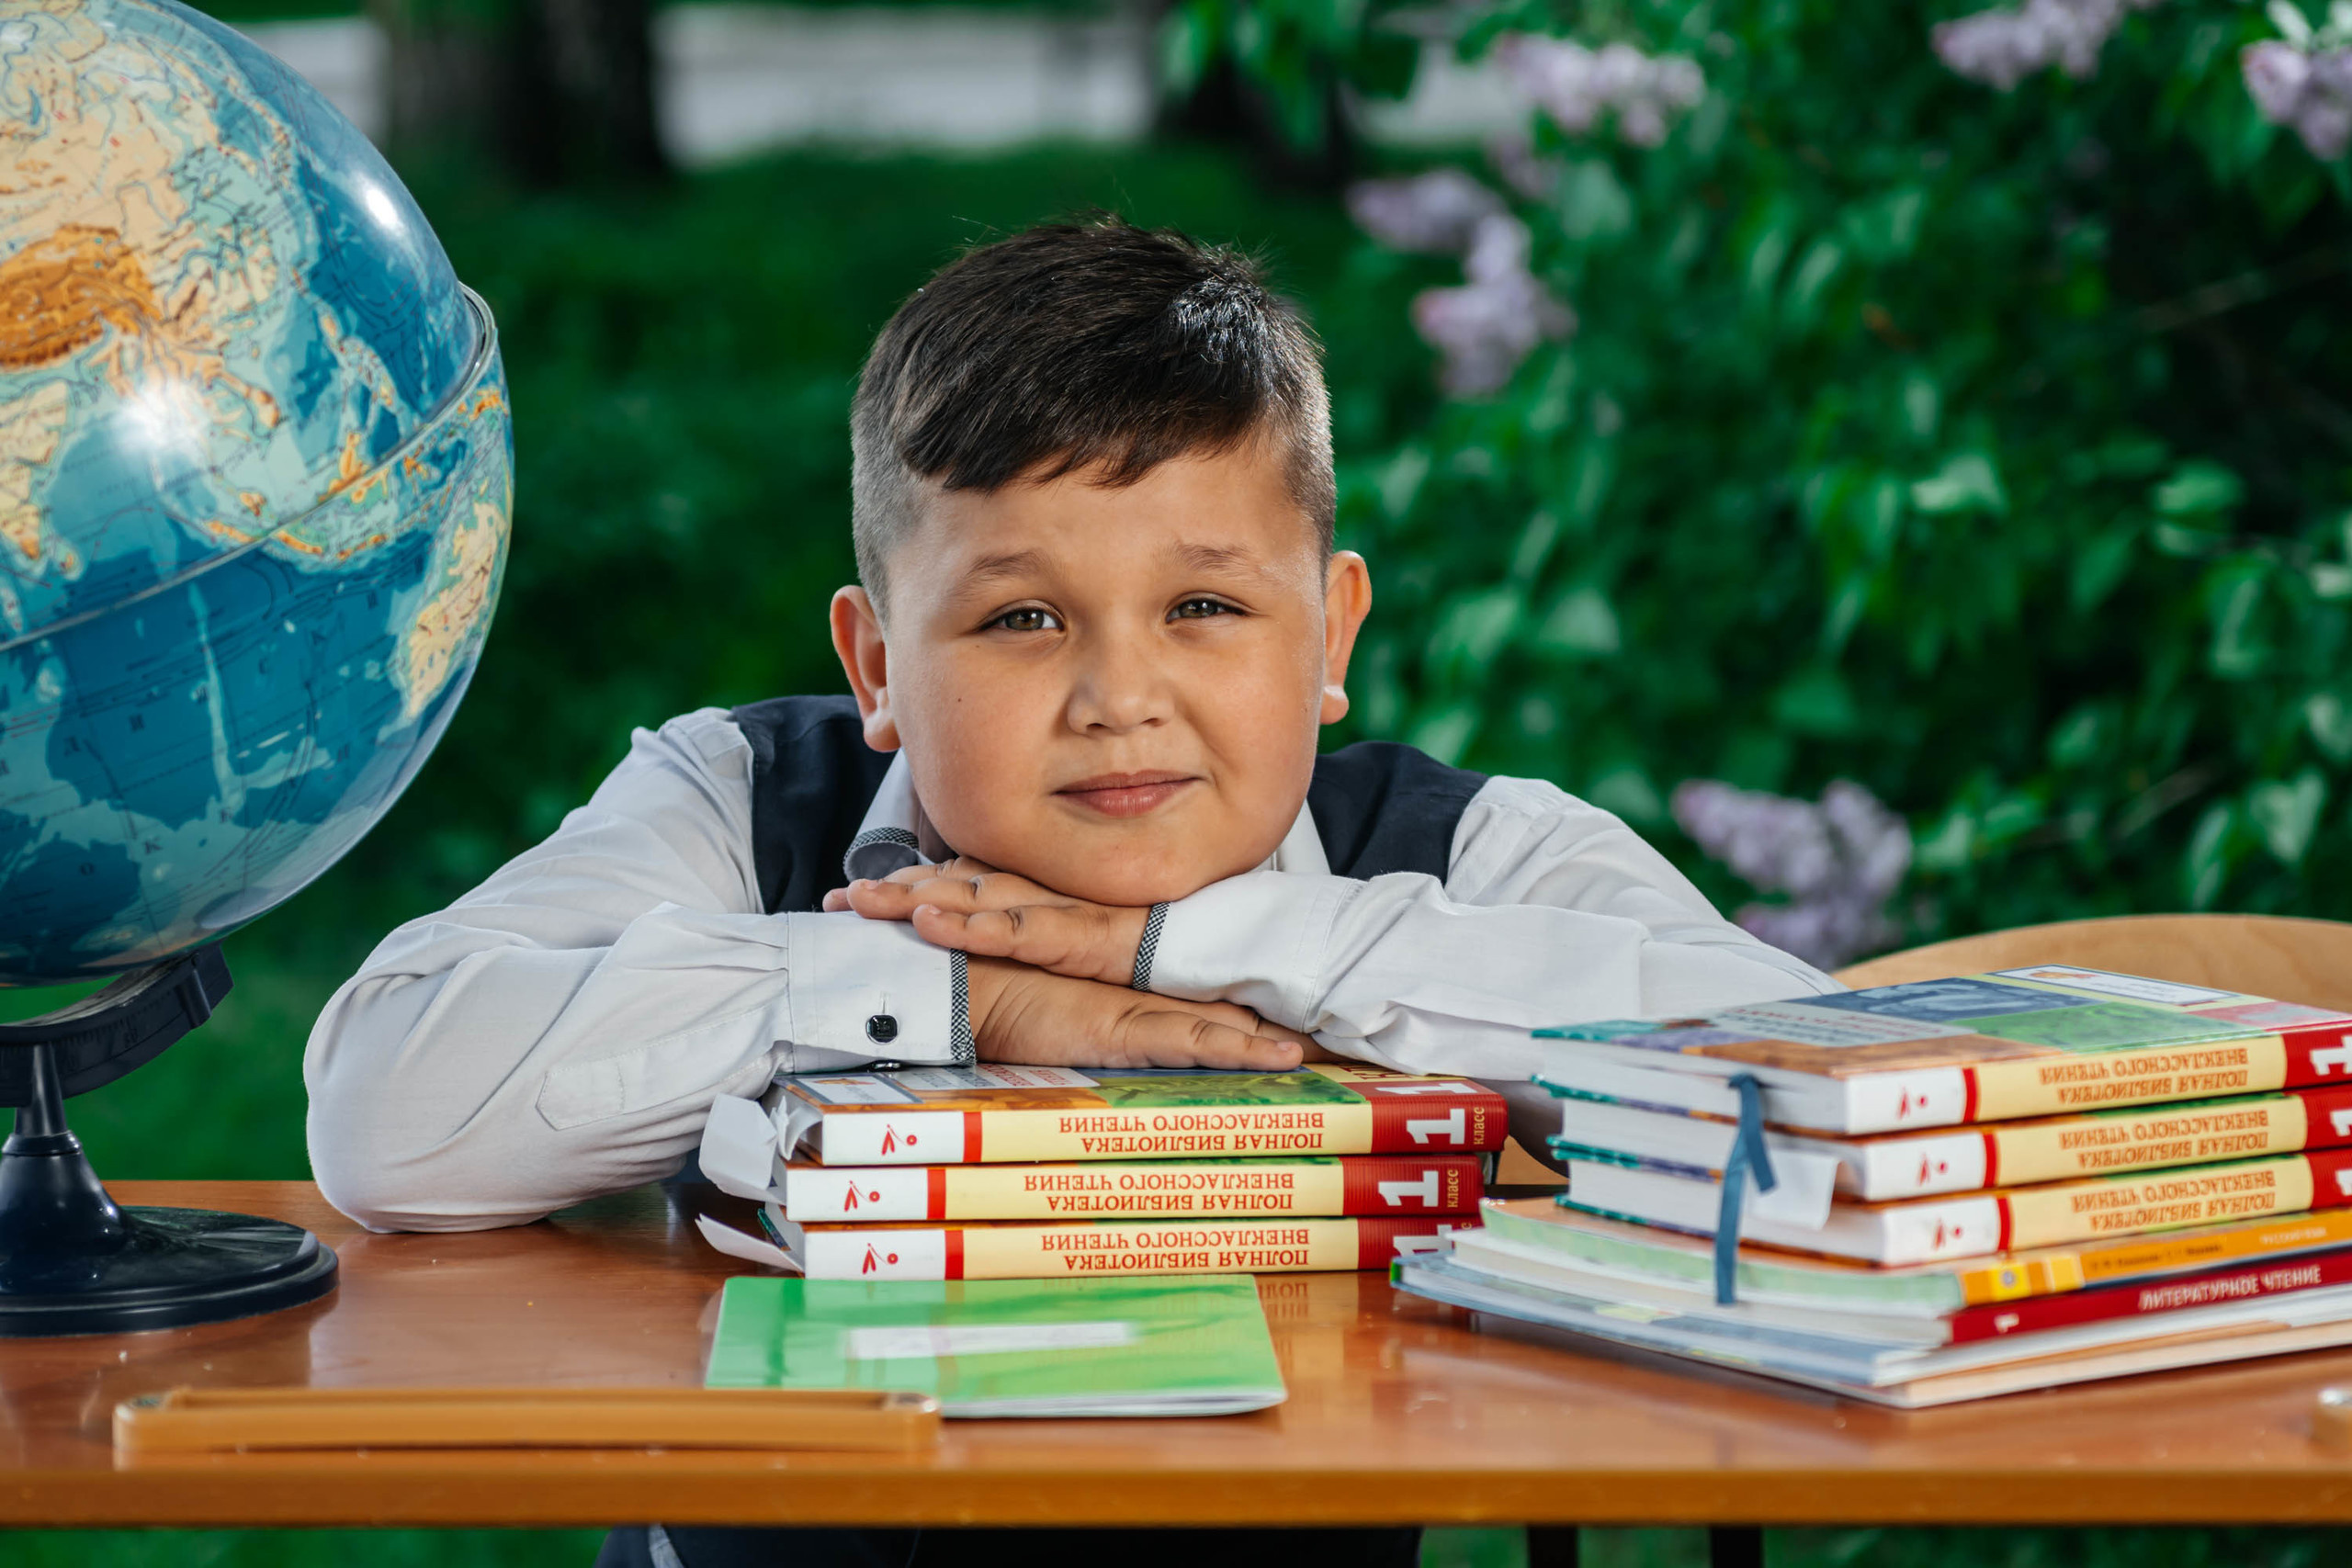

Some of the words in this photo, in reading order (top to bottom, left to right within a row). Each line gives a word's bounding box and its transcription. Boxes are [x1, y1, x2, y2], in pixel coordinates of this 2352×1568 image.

[2040, 1063, 2110, 1085] ЧТЕНИЯ
[2113, 1048, 2248, 1077] ВНЕКЛАССНОГО
[2058, 1077, 2172, 1104] БИБЛИОТЕКА
[2178, 1070, 2248, 1092] ПОЛНАЯ
[1058, 1116, 1147, 1134] ЧТЕНИЯ
[1152, 1112, 1325, 1131] ВНЕКЛАССНОГО
[1407, 1108, 1465, 1145] 1
[1473, 1107, 1485, 1145] класс
[2132, 1110, 2269, 1140] ВНЕКЛАССНОГО
[1080, 1135, 1226, 1153] БИБЛИОТЕКА
[1233, 1133, 1323, 1150] ПОЛНАЯ
[2059, 1127, 2130, 1150] ЧТЕНИЯ
[2198, 1132, 2268, 1156] ПОЛНАЯ
[2077, 1141, 2192, 1168] БИБЛИОТЕКА
[1023, 1174, 1113, 1191] ЧТЕНИЯ
[1118, 1173, 1295, 1190] ВНЕКЛАССНОГО
[1378, 1170, 1439, 1207] 1
[1446, 1168, 1459, 1208] класс
[2143, 1170, 2276, 1202] ВНЕКЛАССНОГО
[1046, 1194, 1193, 1212] БИБЛИОТЕКА
[1202, 1193, 1294, 1210] ПОЛНАЯ
[2070, 1188, 2141, 1213] ЧТЕНИЯ
[2207, 1191, 2276, 1216] ПОЛНАЯ
[2090, 1201, 2202, 1231] БИБЛИОТЕКА
[1041, 1233, 1129, 1251] ЧТЕНИЯ
[1136, 1228, 1309, 1248] ВНЕКЛАССНОГО
[1064, 1252, 1209, 1270] БИБЛИОТЕКА
[1218, 1249, 1308, 1268] ПОЛНАЯ
[2139, 1274, 2260, 1311] ЛИТЕРАТУРНОЕ
[2261, 1264, 2323, 1296] ЧТЕНИЕ
